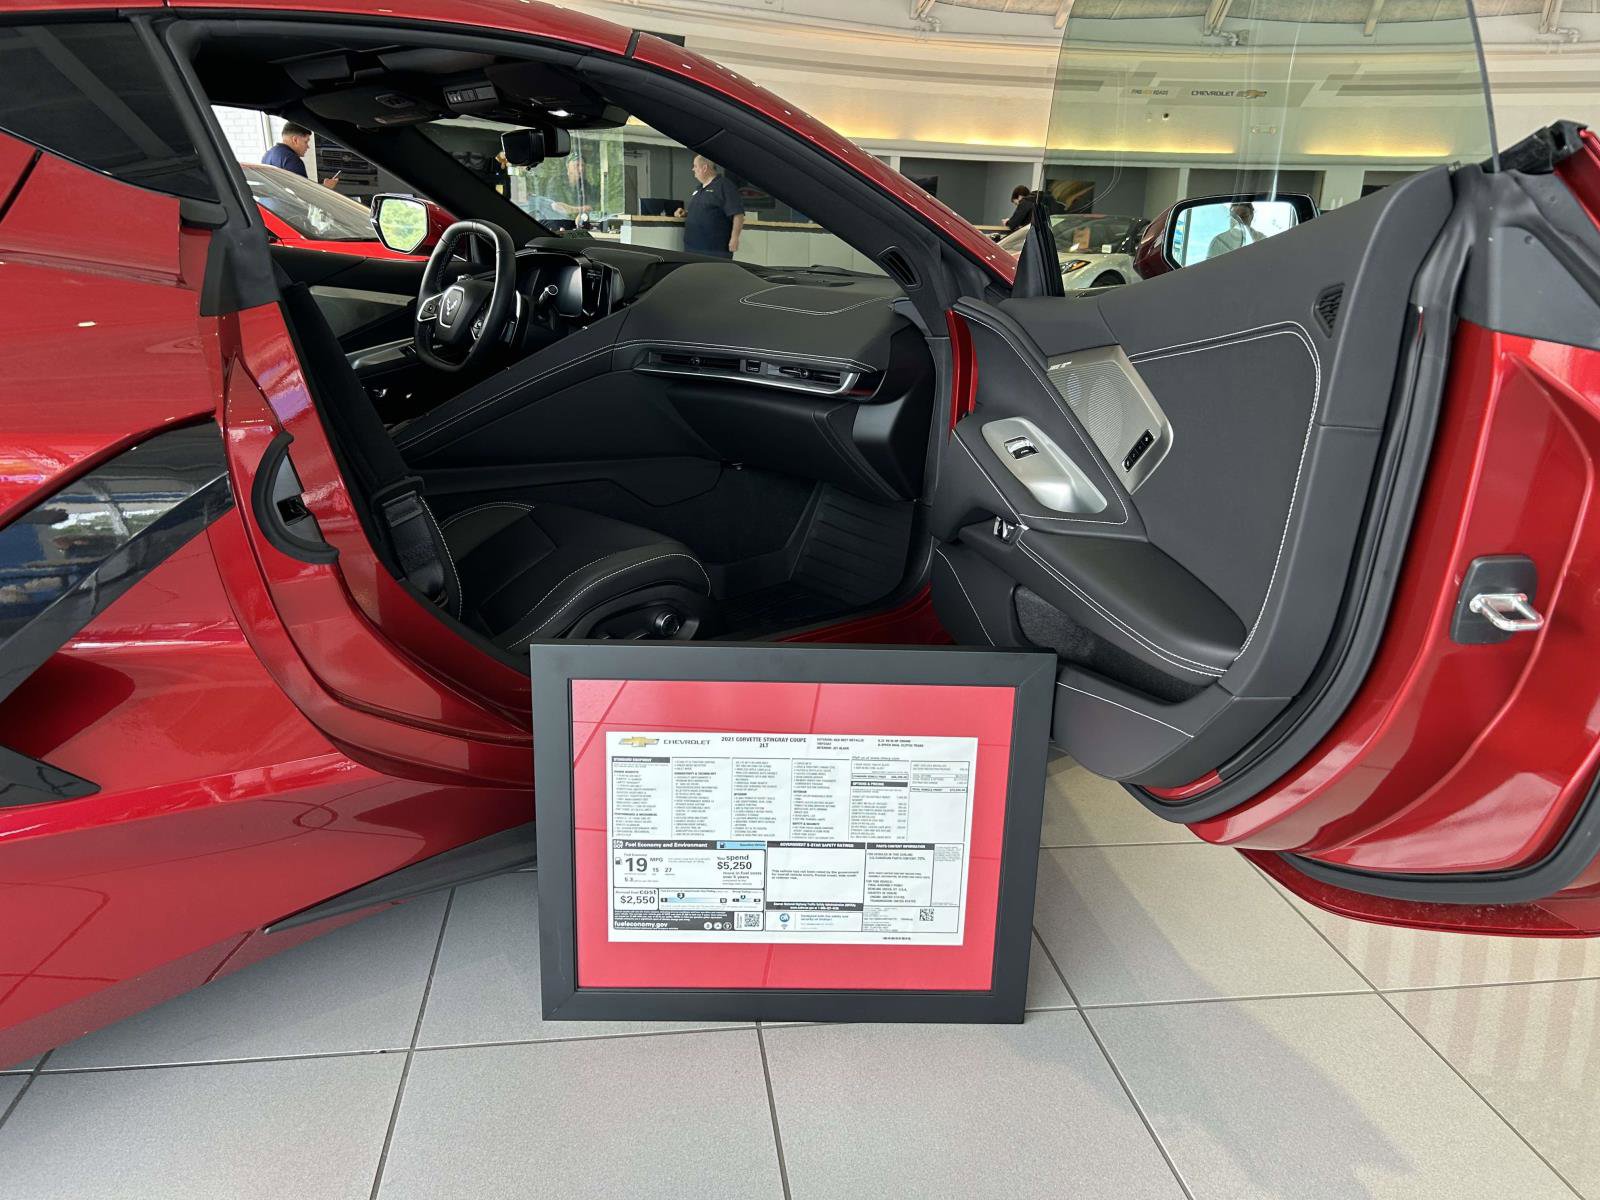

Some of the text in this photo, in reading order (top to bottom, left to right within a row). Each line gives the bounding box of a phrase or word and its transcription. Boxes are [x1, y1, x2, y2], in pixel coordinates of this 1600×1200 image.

[625, 857, 648, 872] 19
[717, 861, 752, 871] $5,250
[620, 895, 656, 905] $2,550
